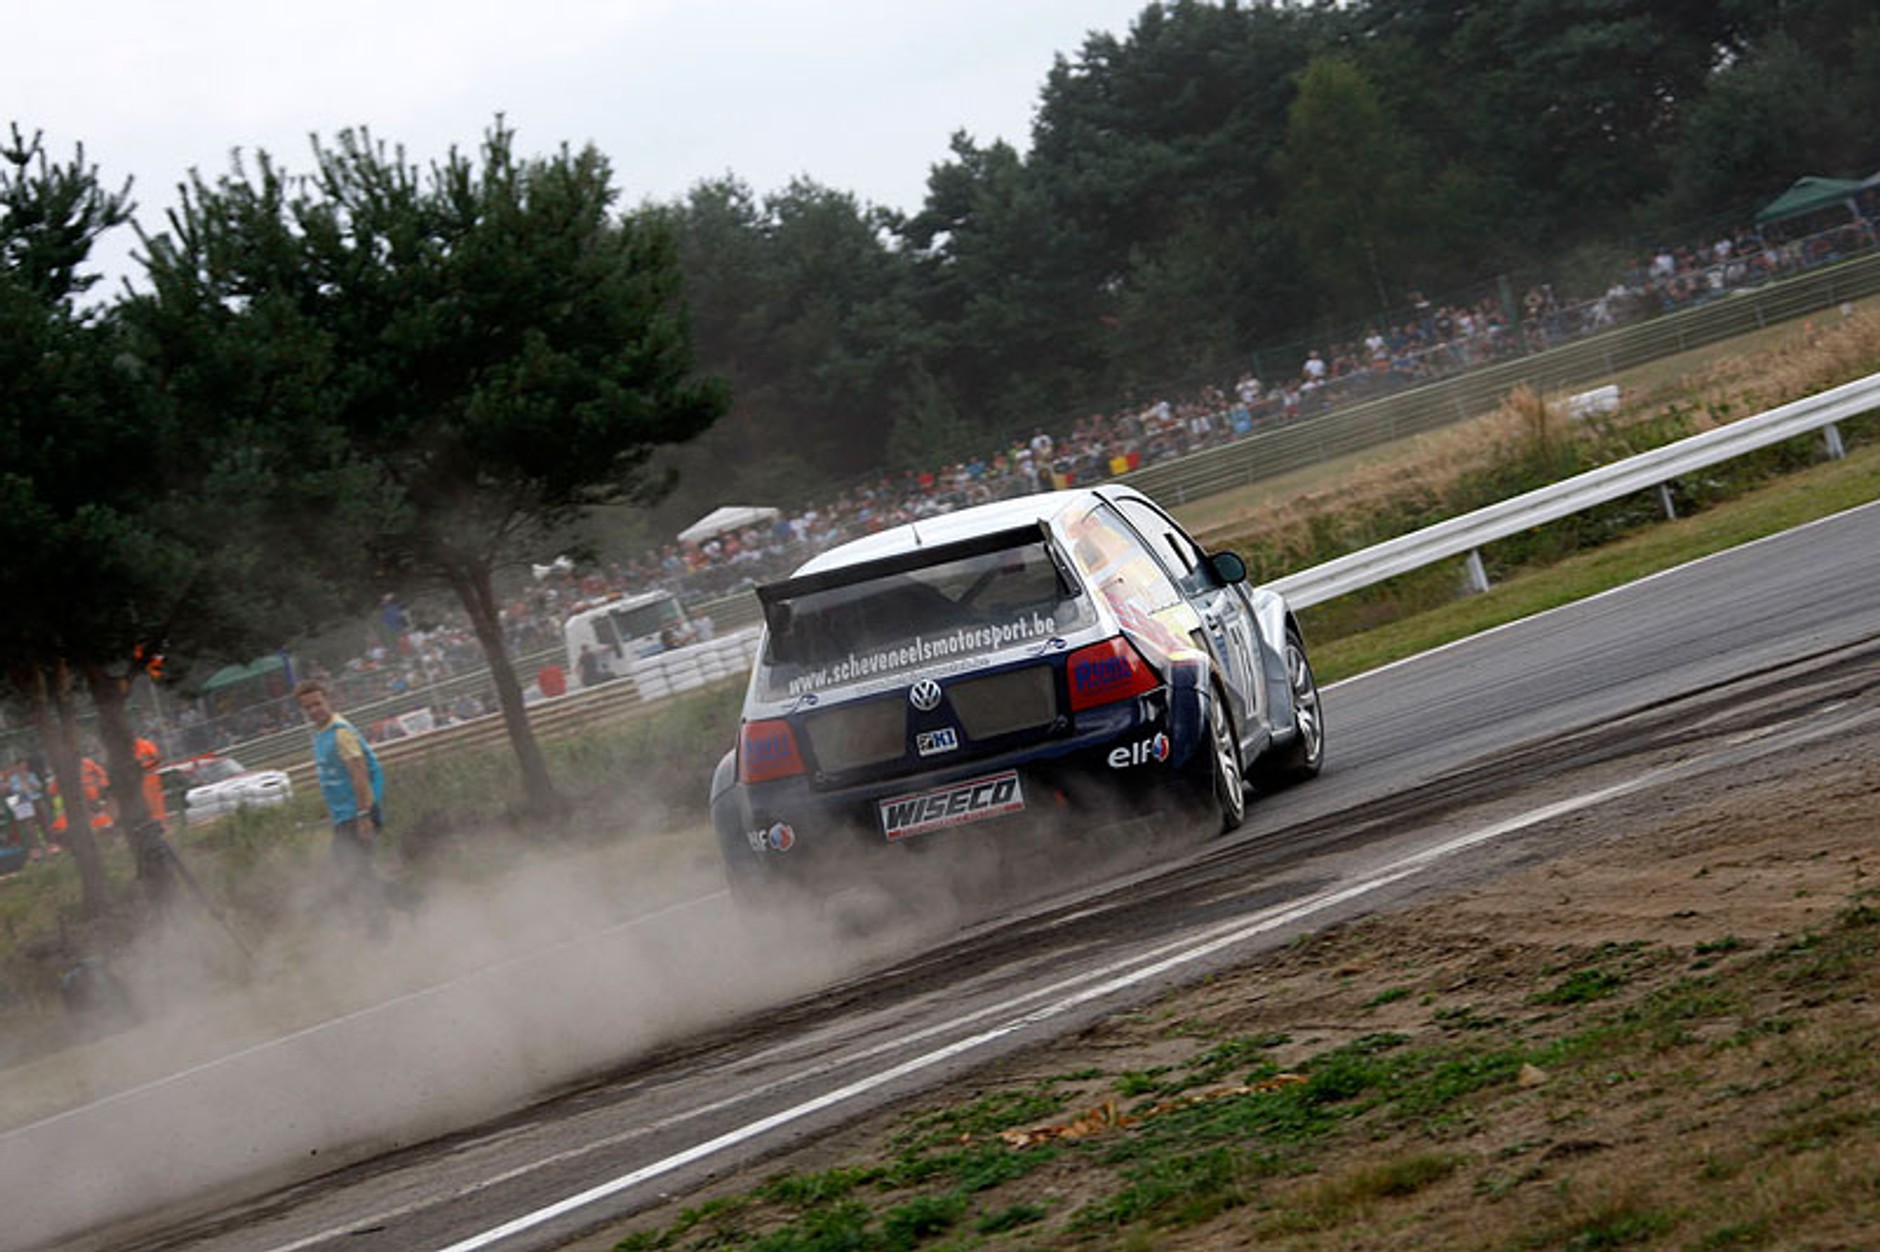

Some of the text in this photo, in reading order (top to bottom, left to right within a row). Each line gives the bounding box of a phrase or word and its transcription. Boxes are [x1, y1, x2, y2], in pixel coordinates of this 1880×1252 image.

[788, 611, 1056, 696] www.scheveneelsmotorsport.be
[1107, 738, 1152, 769] elf
[886, 778, 1017, 830] WISECO
